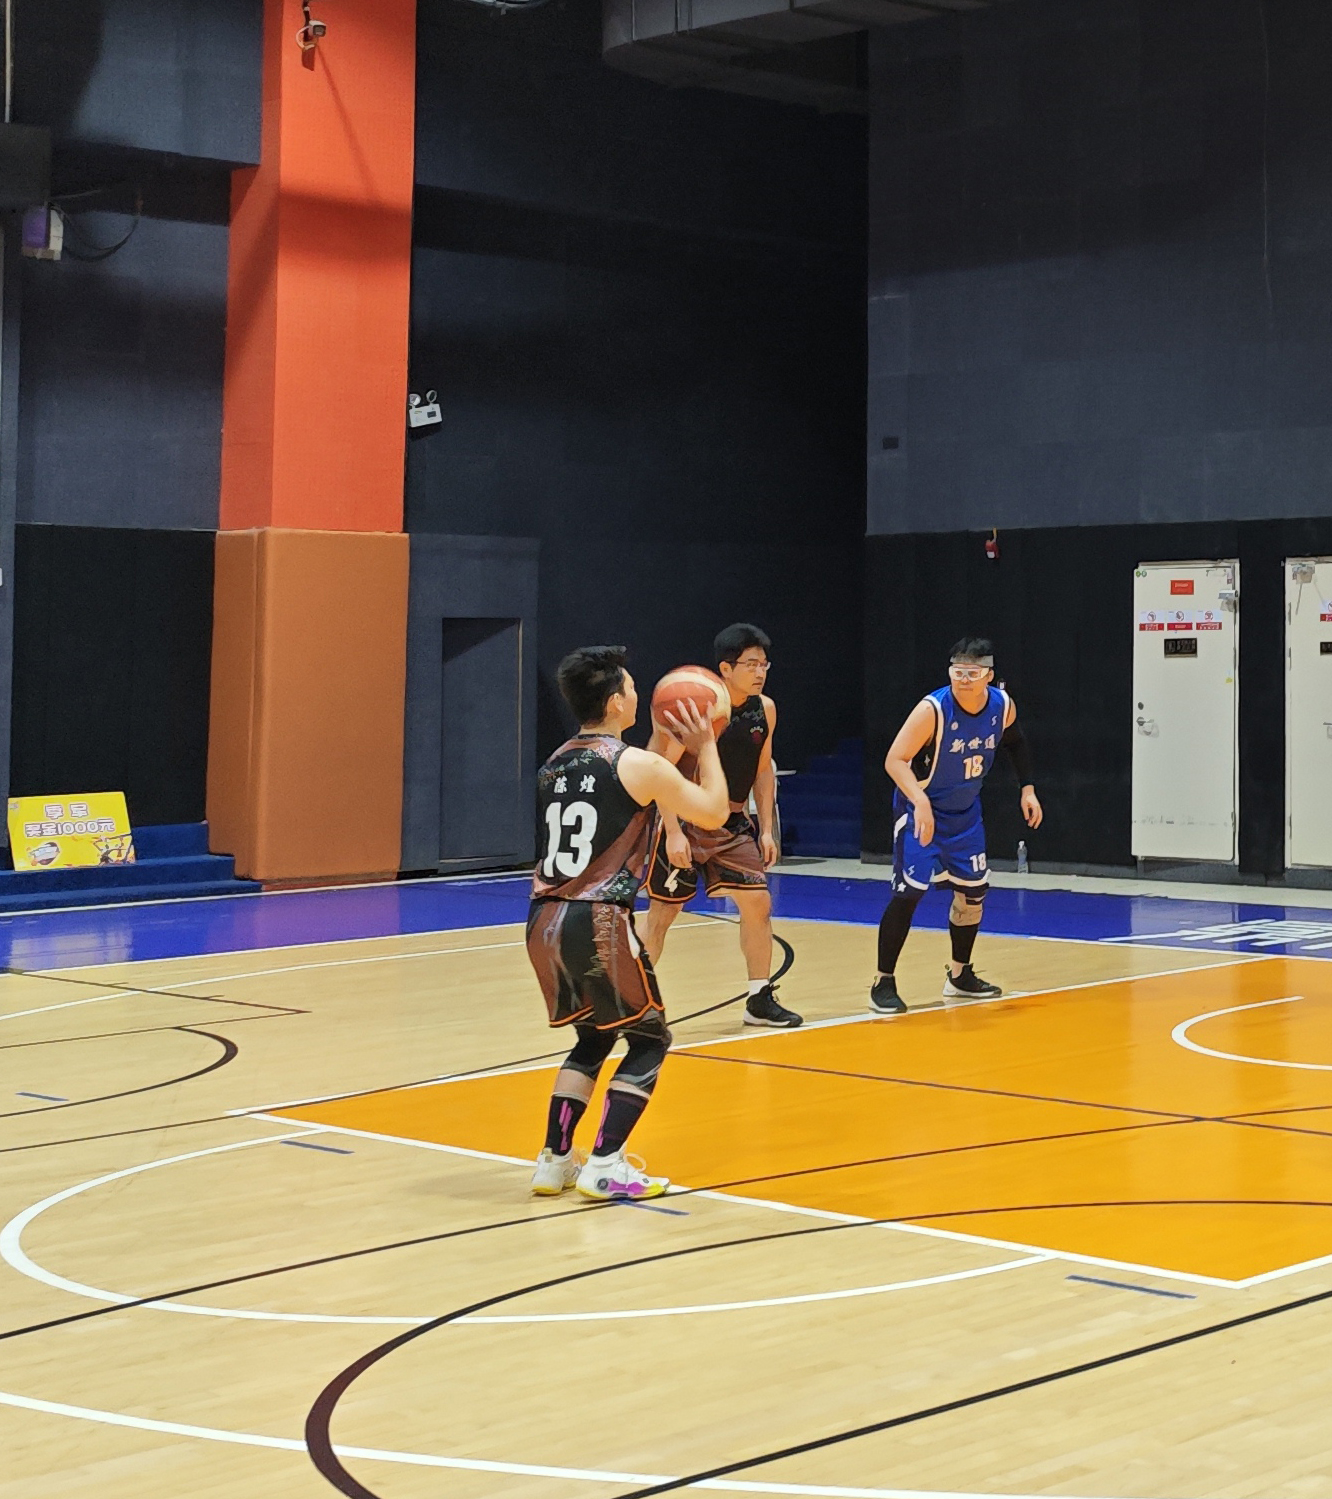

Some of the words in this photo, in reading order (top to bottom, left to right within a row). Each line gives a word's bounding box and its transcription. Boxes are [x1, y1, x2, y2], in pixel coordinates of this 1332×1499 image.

[963, 755, 984, 780] 18
[25, 819, 115, 837] 奖金1000元
[543, 801, 598, 878] 13
[970, 852, 987, 873] 18
